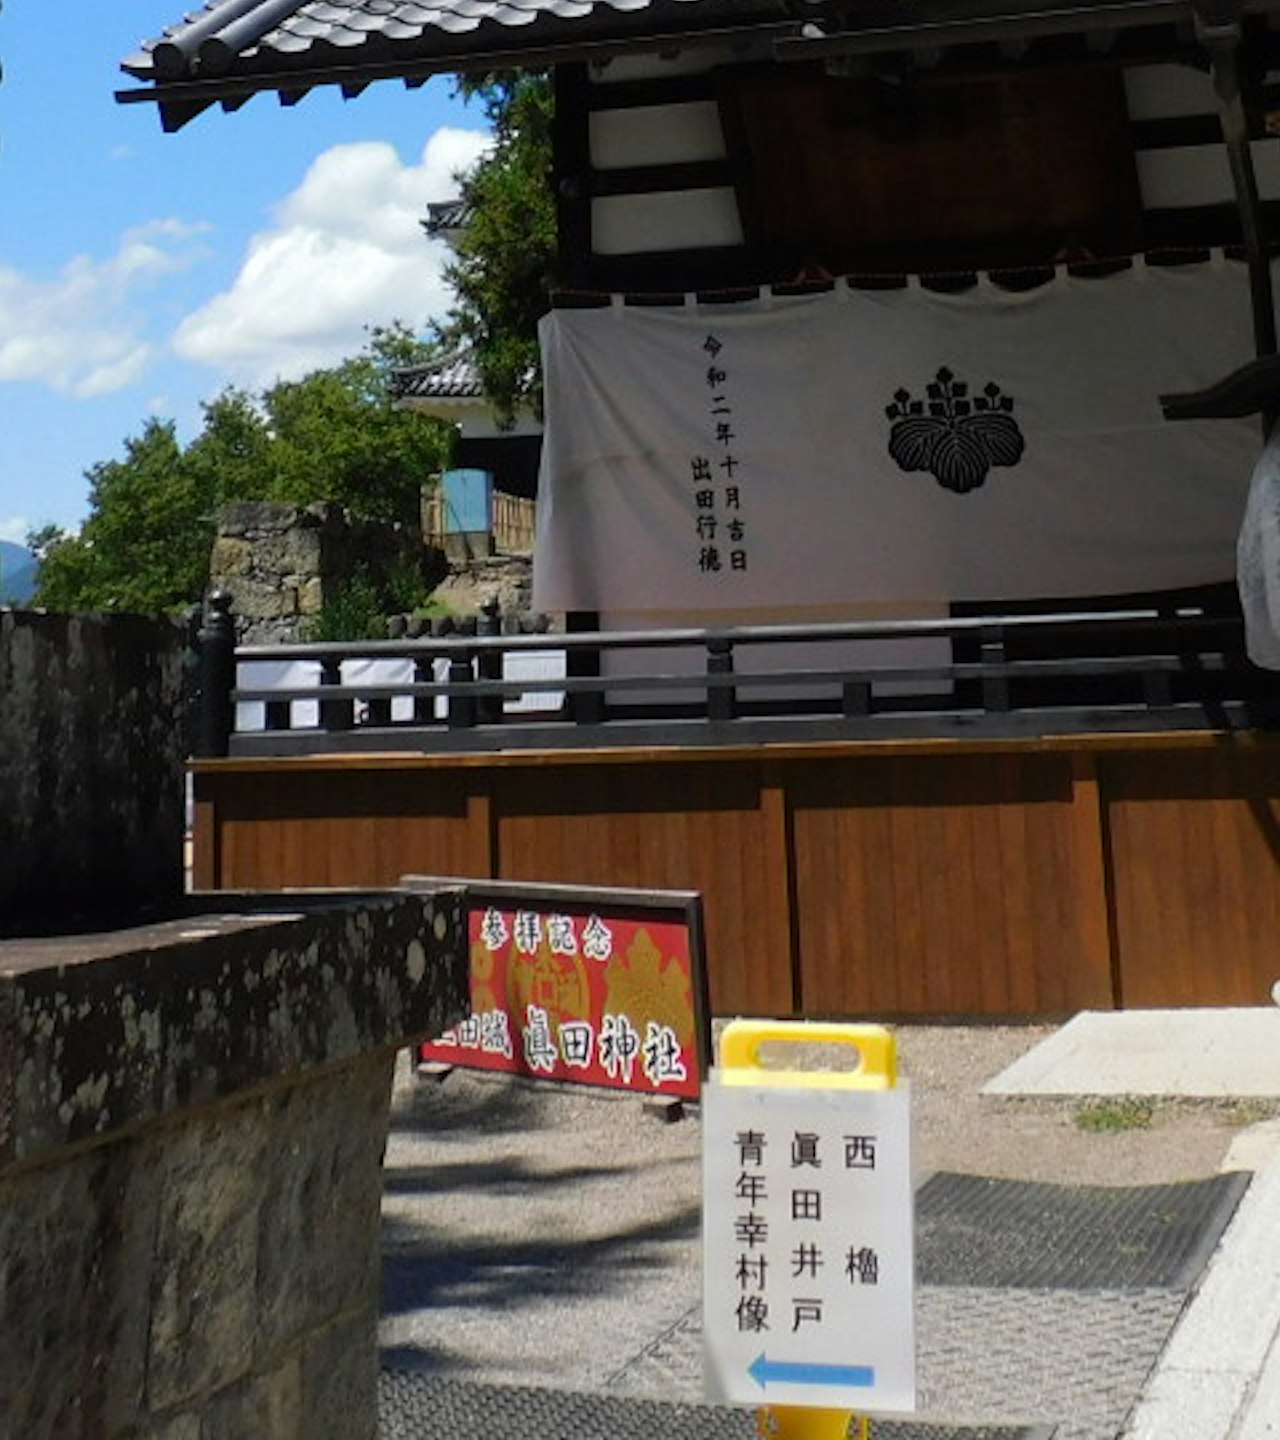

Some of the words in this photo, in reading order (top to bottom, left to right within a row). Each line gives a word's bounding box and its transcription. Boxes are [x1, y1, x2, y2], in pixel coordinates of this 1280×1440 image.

[702, 334, 748, 572] 令和二年十月吉日
[733, 1130, 771, 1333] 青年幸村像
[790, 1131, 825, 1333] 眞田井戸
[842, 1134, 879, 1286] 西櫓
